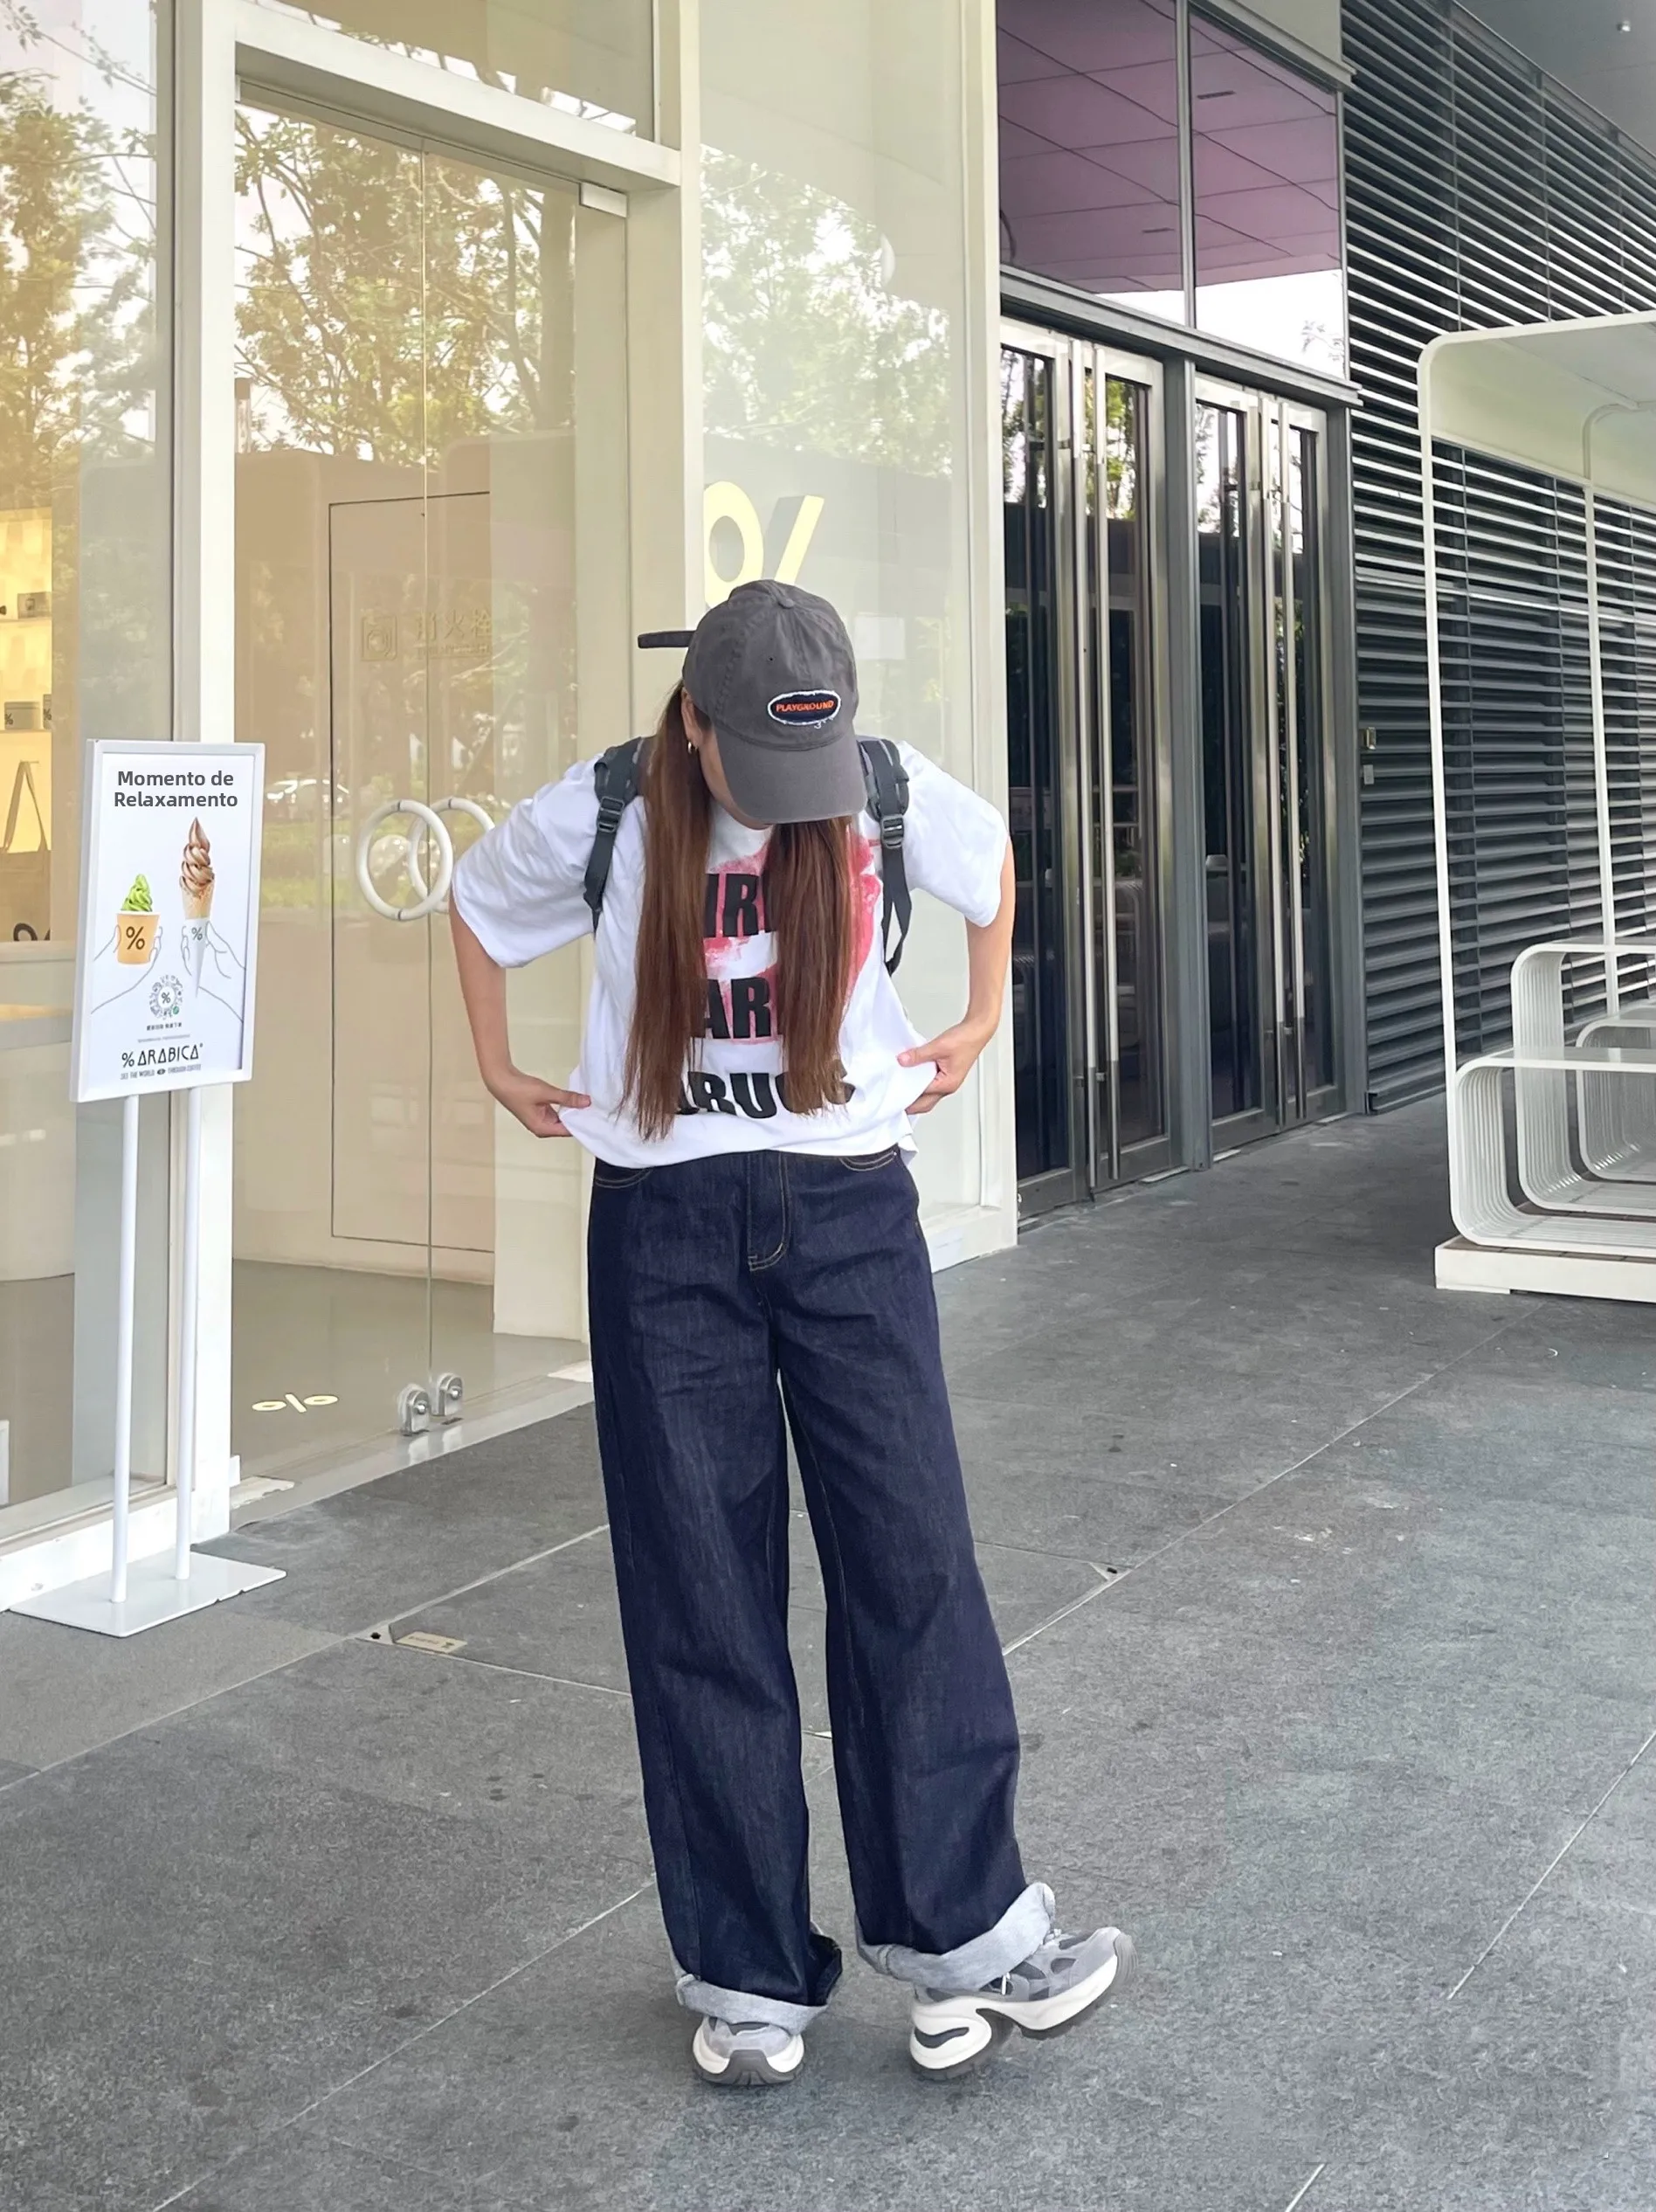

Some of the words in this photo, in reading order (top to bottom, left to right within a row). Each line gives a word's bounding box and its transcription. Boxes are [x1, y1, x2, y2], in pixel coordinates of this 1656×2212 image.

[776, 700, 834, 712] PLAYGROUND
[117, 771, 205, 786] Momento
[210, 770, 234, 786] de
[114, 791, 238, 807] Relaxamento
[137, 1044, 199, 1067] ARABICA
